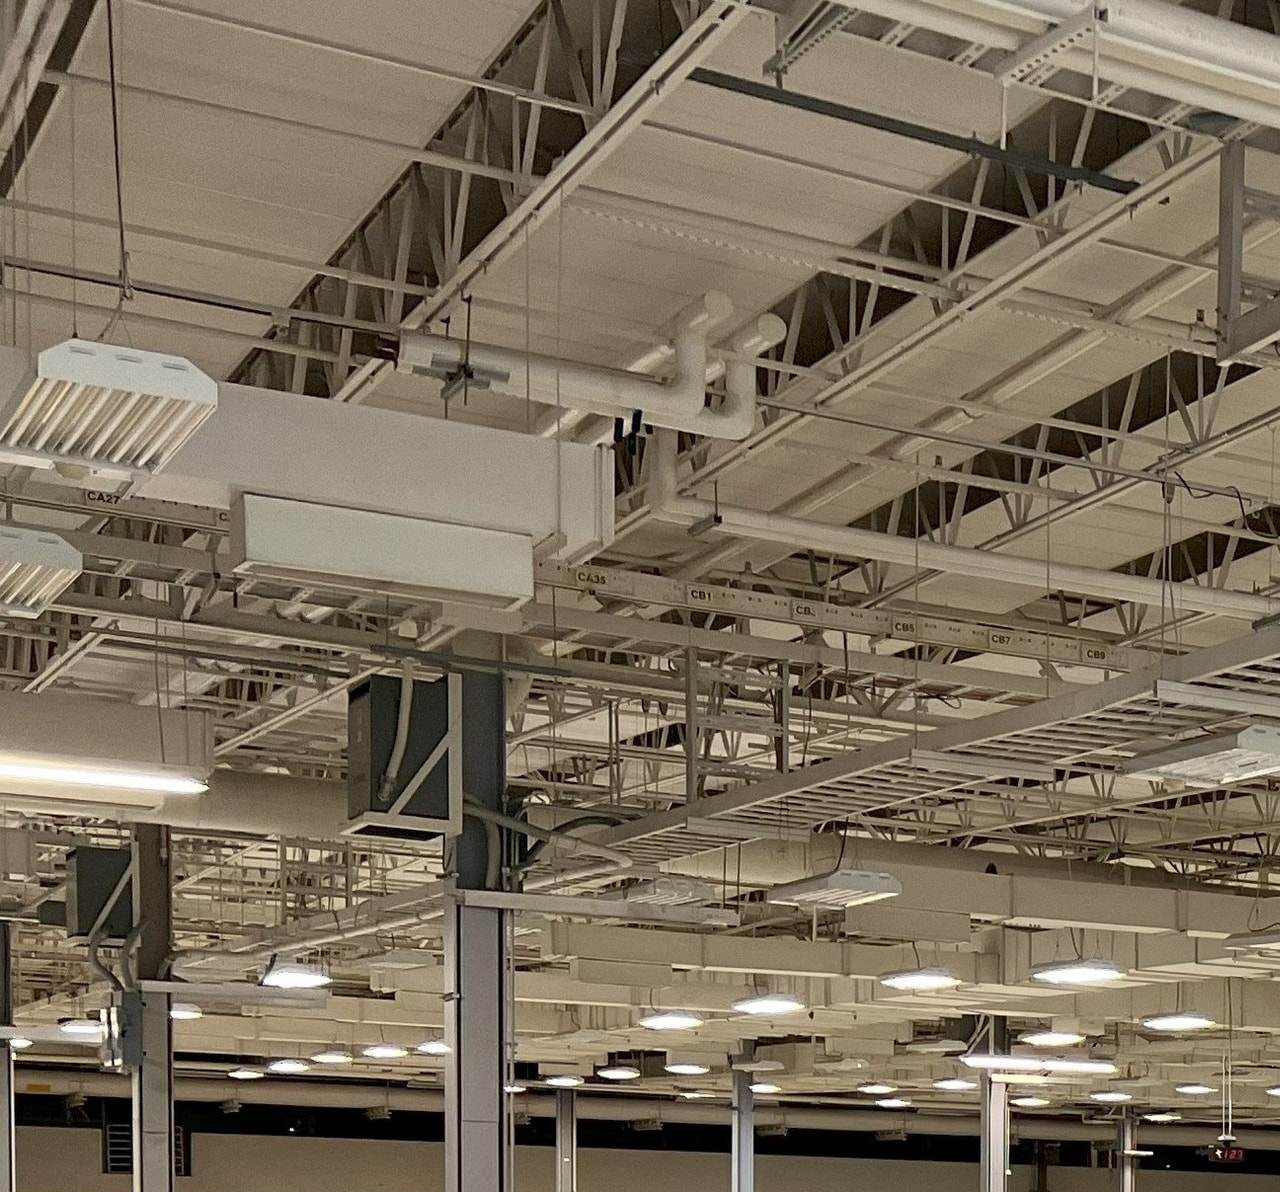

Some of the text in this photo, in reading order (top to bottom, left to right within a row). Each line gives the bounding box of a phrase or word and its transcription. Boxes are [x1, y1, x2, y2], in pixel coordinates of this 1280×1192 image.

[87, 491, 121, 505] CA27
[690, 589, 712, 601] CB1
[795, 605, 816, 617] CB
[894, 622, 915, 632] CB5
[991, 634, 1011, 644] CB7
[1086, 649, 1106, 660] CB9
